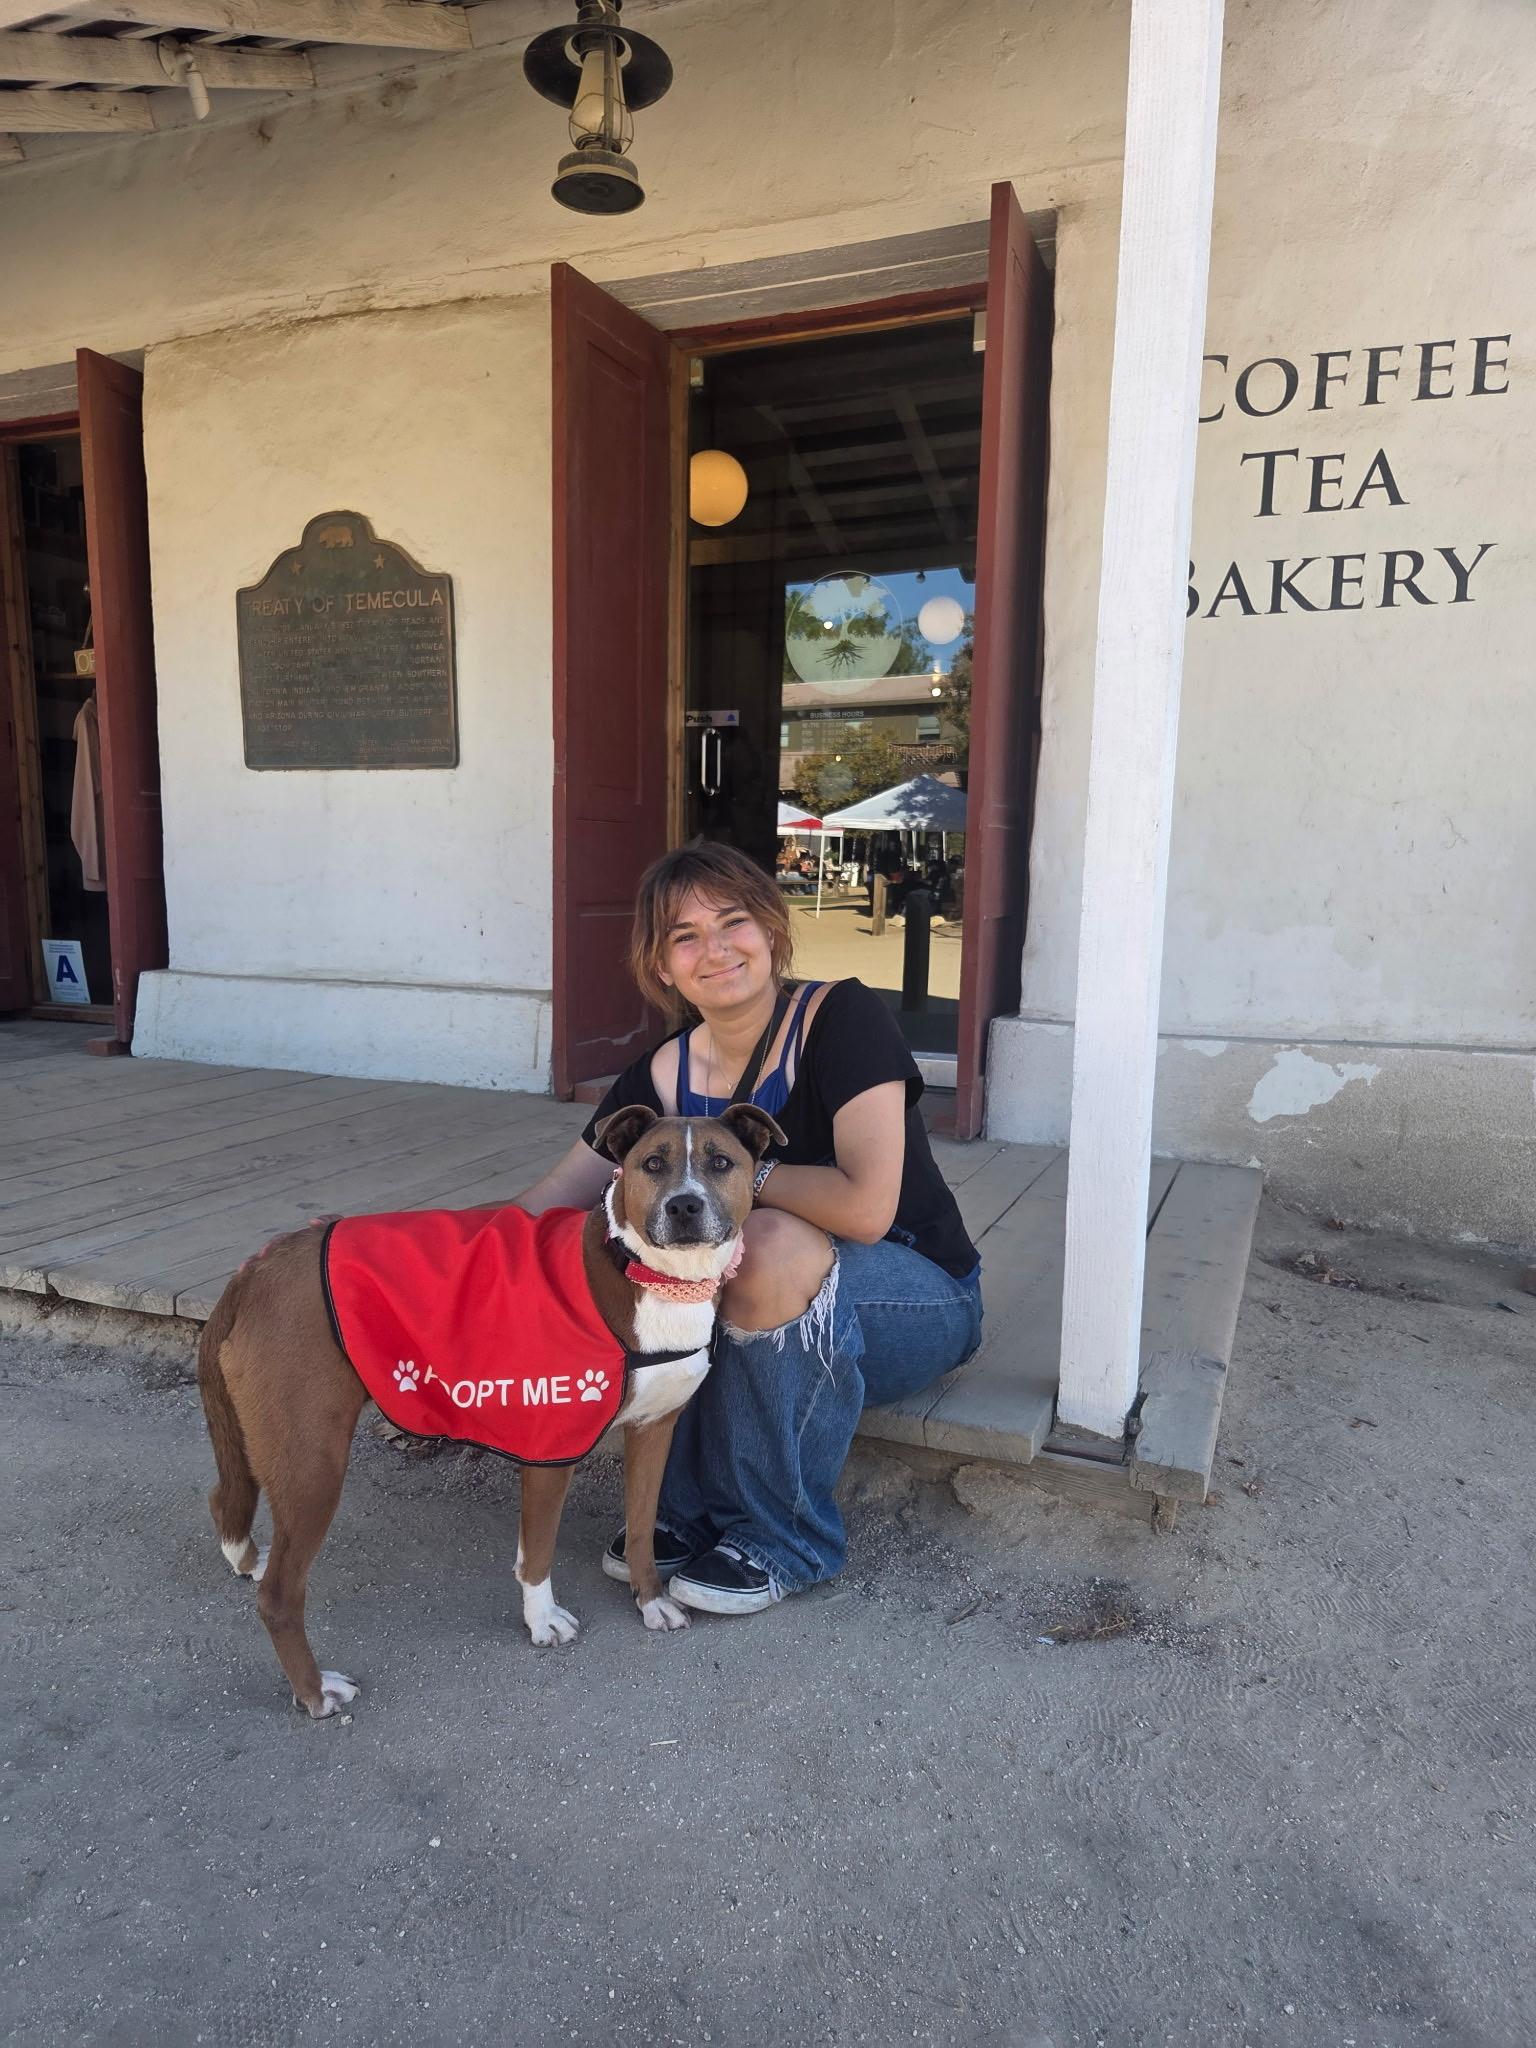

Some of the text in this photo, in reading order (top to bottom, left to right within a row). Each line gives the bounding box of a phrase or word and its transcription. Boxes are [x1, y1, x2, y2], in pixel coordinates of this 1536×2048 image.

[1240, 447, 1410, 518] TEA
[311, 594, 336, 614] OF
[344, 588, 444, 615] TEMECULA
[687, 714, 713, 723] Push
[809, 710, 865, 719] BUSINESS HOURS
[56, 955, 79, 983] A
[522, 1375, 572, 1407] ME
